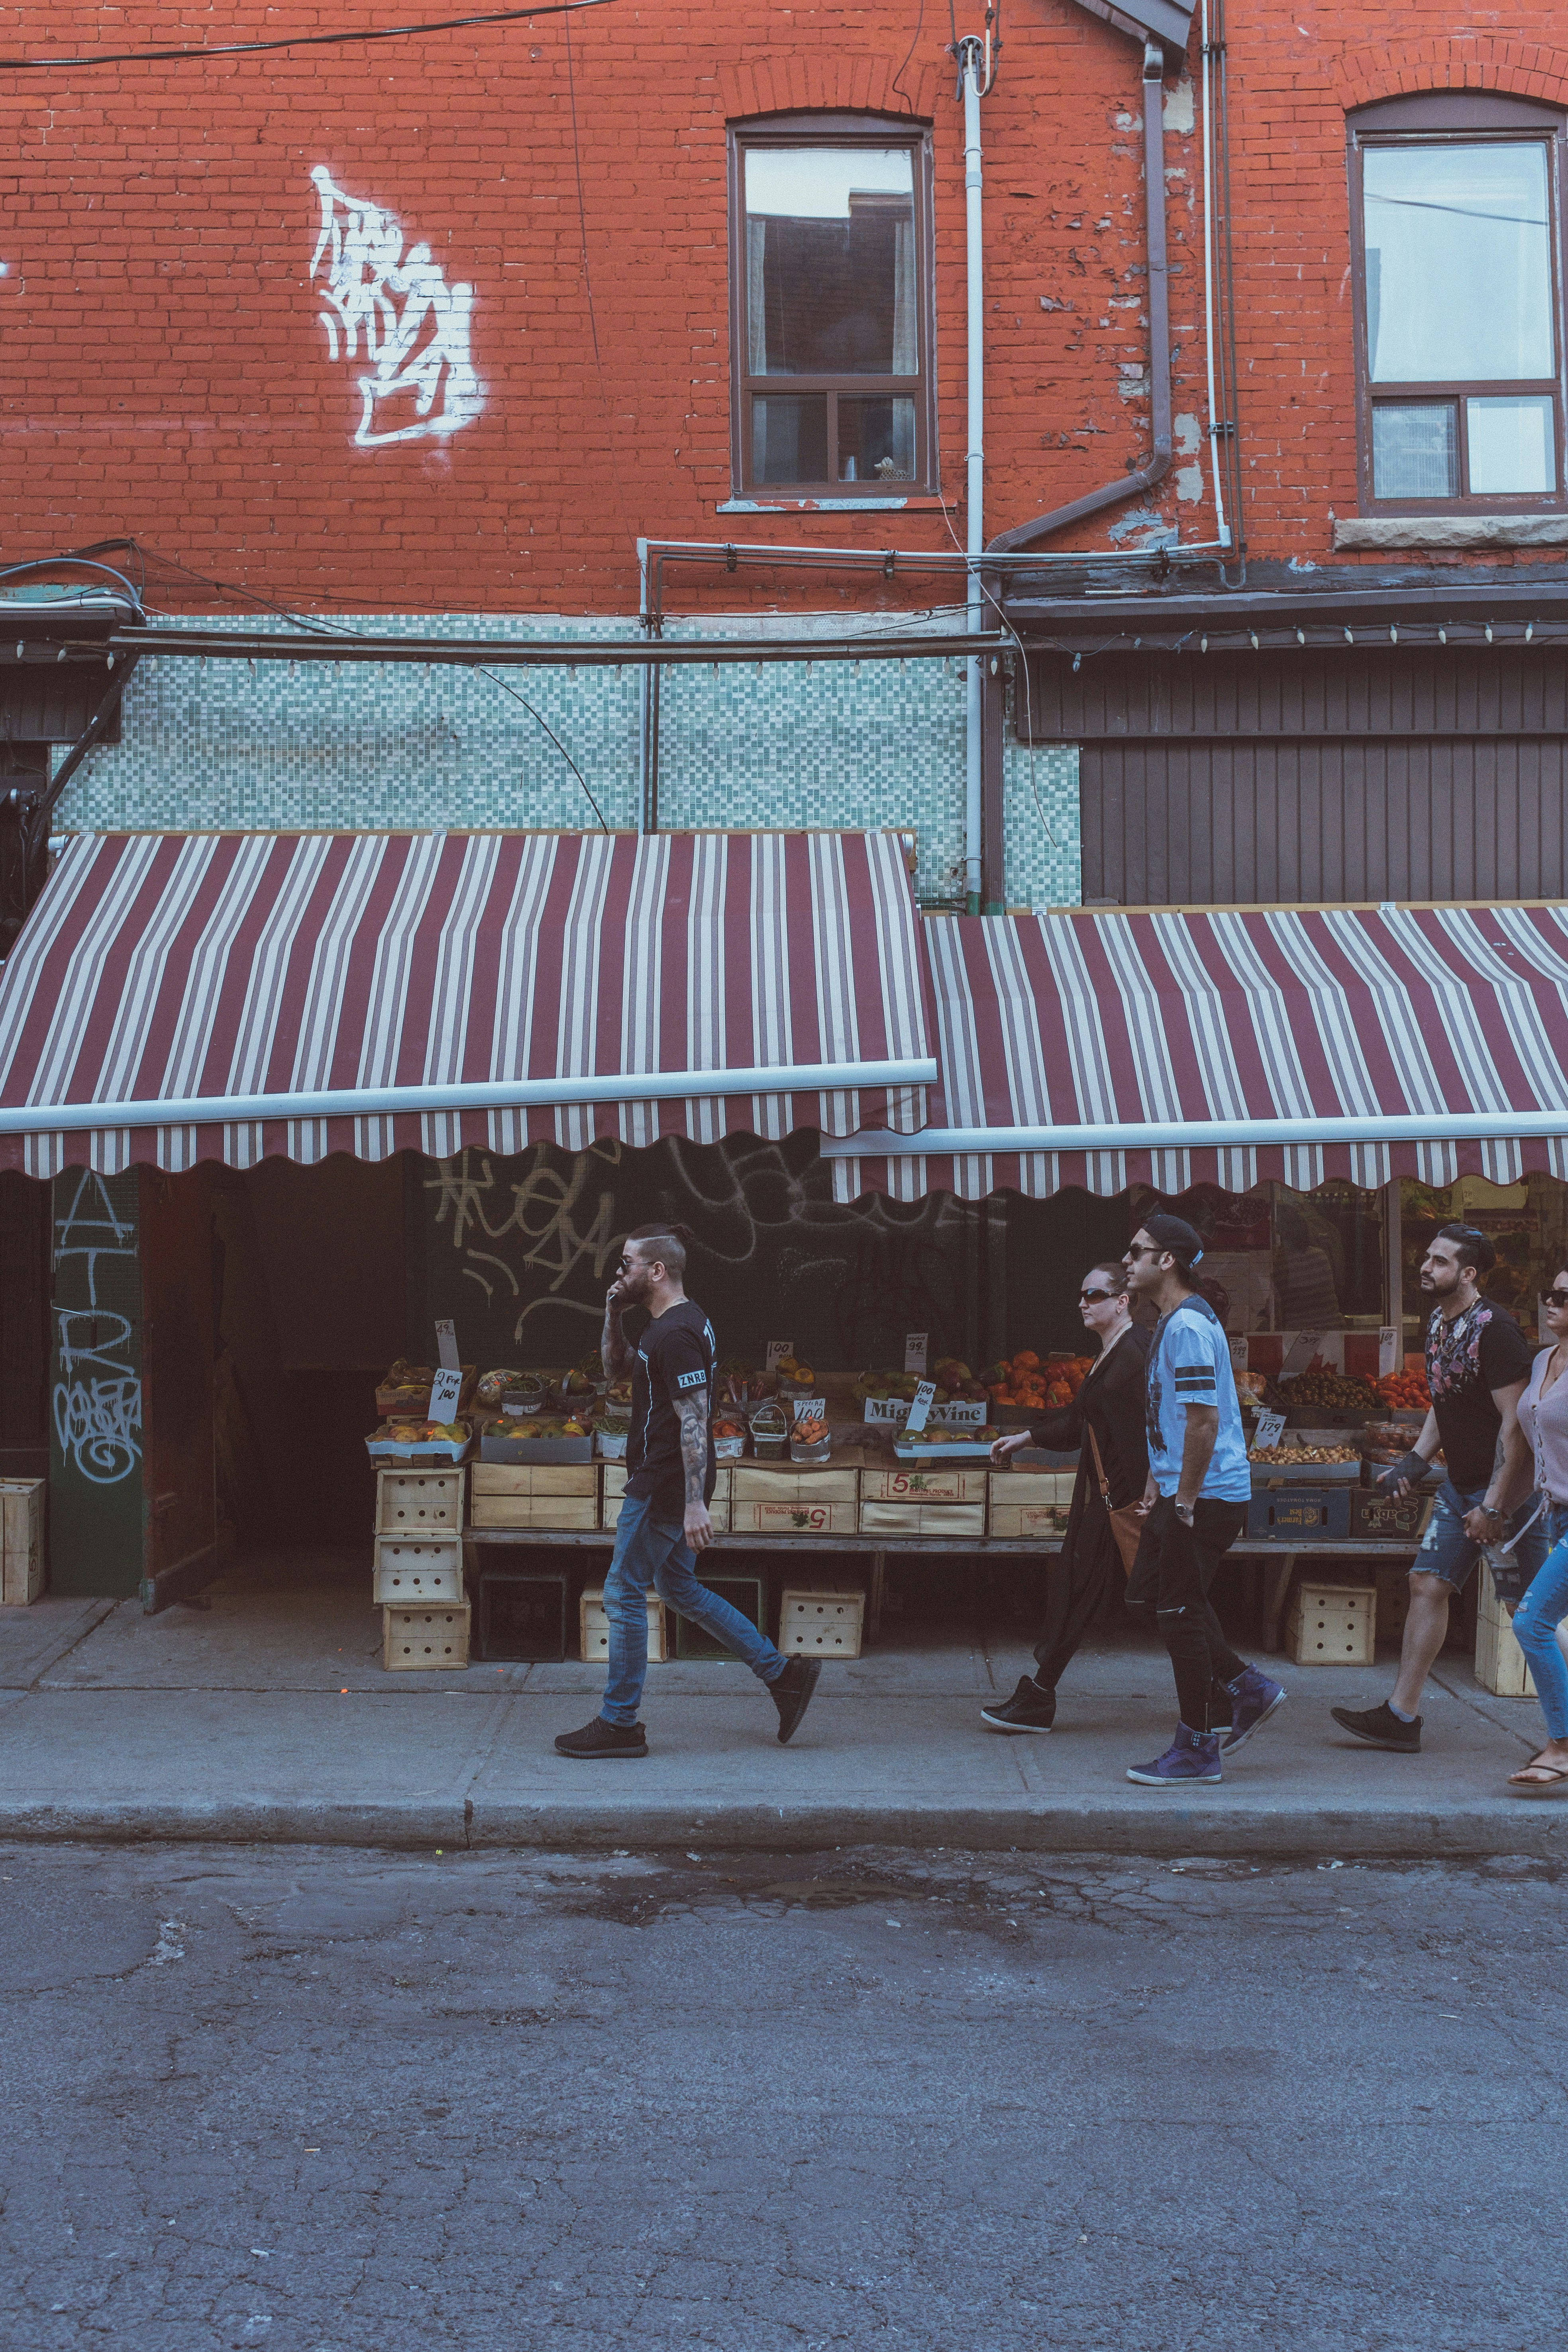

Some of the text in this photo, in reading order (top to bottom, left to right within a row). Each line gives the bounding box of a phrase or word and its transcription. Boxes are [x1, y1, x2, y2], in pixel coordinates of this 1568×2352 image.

[434, 1372, 445, 1387] 2
[680, 1372, 705, 1386] ZNRB
[870, 1402, 981, 1422] MigyVine
[1260, 1421, 1281, 1432] 1.79
[892, 1473, 909, 1493] 5
[809, 1509, 826, 1528] 5
[1277, 1517, 1302, 1525] Farmer's
